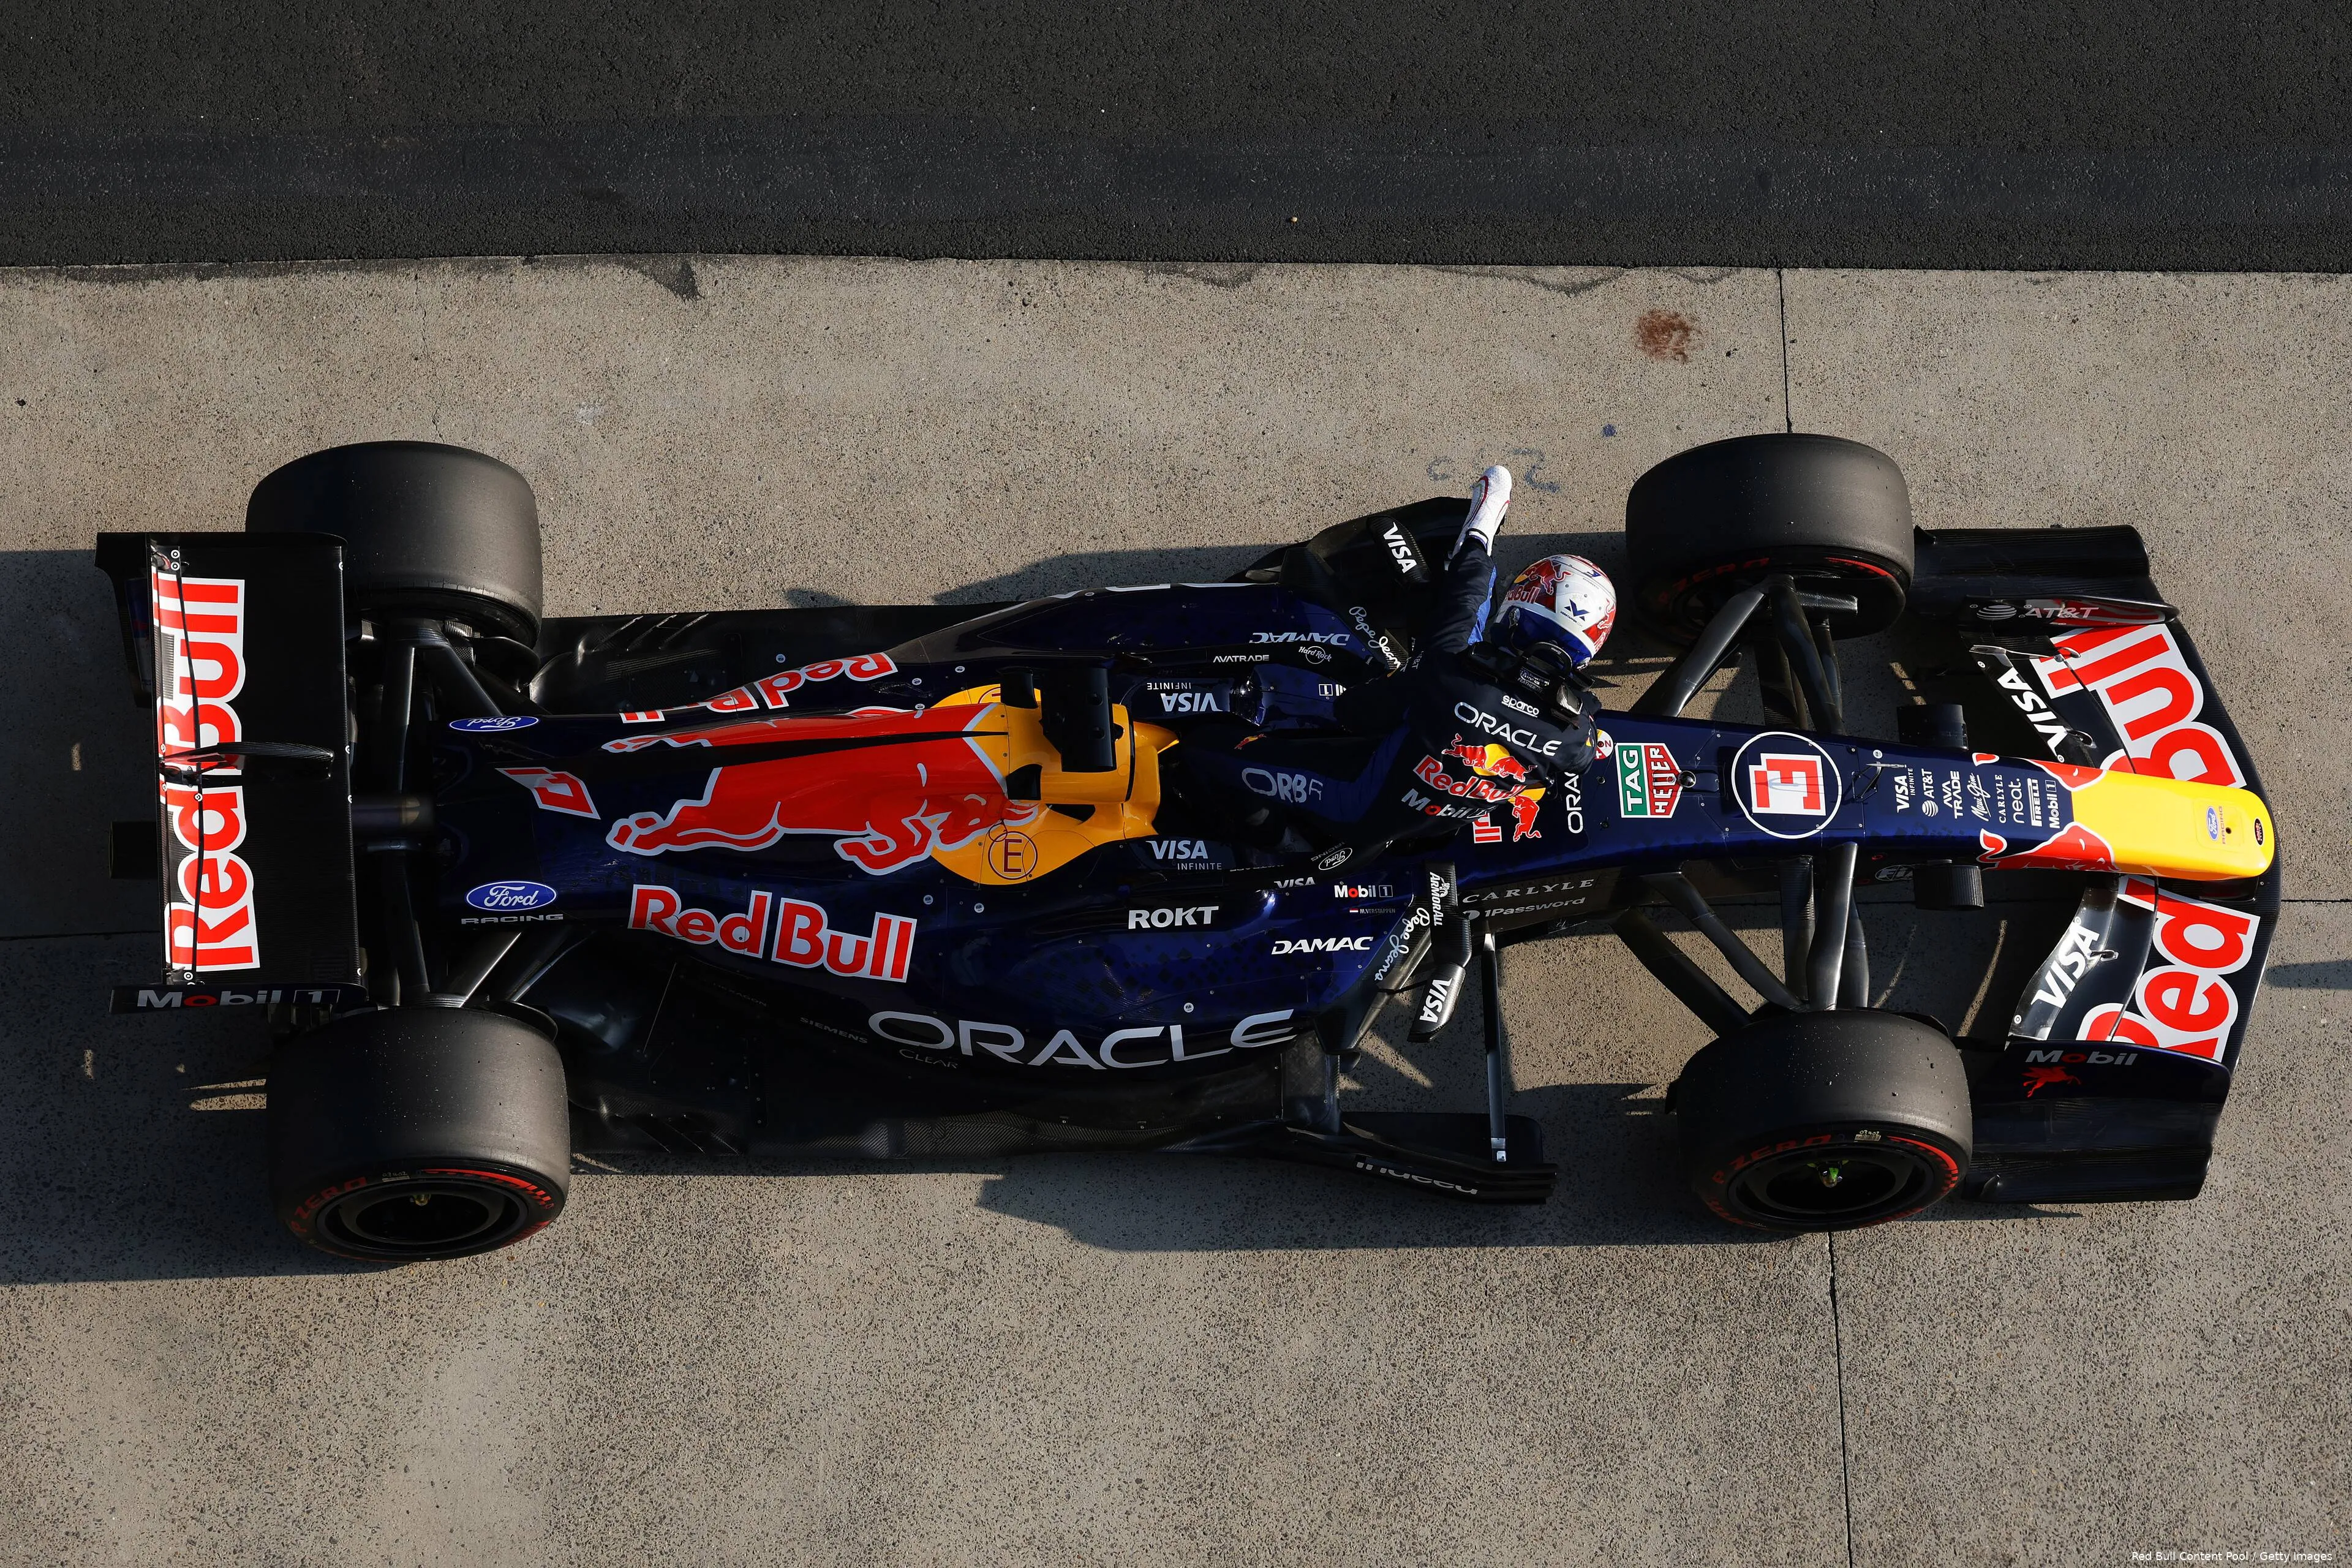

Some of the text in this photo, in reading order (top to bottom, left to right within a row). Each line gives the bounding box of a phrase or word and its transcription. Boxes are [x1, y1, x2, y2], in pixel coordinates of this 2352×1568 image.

[1383, 522, 1417, 573] VISA
[1348, 606, 1377, 639] Pepe
[2023, 606, 2100, 619] AT&T
[1250, 631, 1350, 646] DAMAC
[1213, 654, 1270, 663] AVATRADE
[1298, 646, 1332, 662] Hard Rock
[154, 579, 244, 774] Bull
[754, 652, 899, 709] Red
[1147, 682, 1191, 690] INFINITE
[1160, 693, 1223, 712] VISA
[1501, 695, 1539, 716] sparco
[1997, 667, 2068, 758] VISA
[2034, 625, 2245, 788] Bull
[467, 717, 522, 731] Ford
[1454, 701, 1562, 757] ORACLE
[1413, 755, 1528, 804] Red Bull
[1625, 749, 1643, 812] TAG
[1651, 747, 1677, 813] HEUER
[1894, 775, 1910, 813] VISA
[1907, 767, 1916, 796] INFINITE
[1921, 768, 1935, 799] AT&T
[1401, 788, 1474, 818] Mobil
[1950, 771, 1964, 819] TRADE
[1970, 796, 1991, 822] Maui
[1995, 774, 2007, 824] CARLYLE
[2008, 778, 2025, 824] neat.
[2027, 778, 2043, 827] PIRELLI
[2046, 794, 2060, 829] Mobil
[2208, 813, 2218, 835] Ford
[1003, 839, 1023, 872] E
[1146, 840, 1208, 859] VISA
[1324, 850, 1346, 867] Ford
[160, 783, 260, 971] Red
[1273, 877, 1316, 890] VISA
[1335, 884, 1376, 899] Mobil
[1462, 879, 1594, 903] CARLYLE
[483, 886, 540, 907] Ford
[1485, 897, 1585, 918] 1Password
[461, 914, 564, 924] RACING
[1128, 906, 1219, 930] ROKT
[627, 884, 918, 983] Red Bull
[1271, 937, 1374, 955] DAMAC
[1374, 907, 1431, 981] Pepe Jeans
[2032, 922, 2101, 1009] VISA
[137, 989, 282, 1008] Mobil
[1420, 979, 1454, 1023] VISA
[799, 1016, 869, 1044] SIEMENS
[868, 1008, 1298, 1070] ORACLE
[899, 1049, 960, 1069] CLEAR
[2024, 1049, 2138, 1066] Mobil
